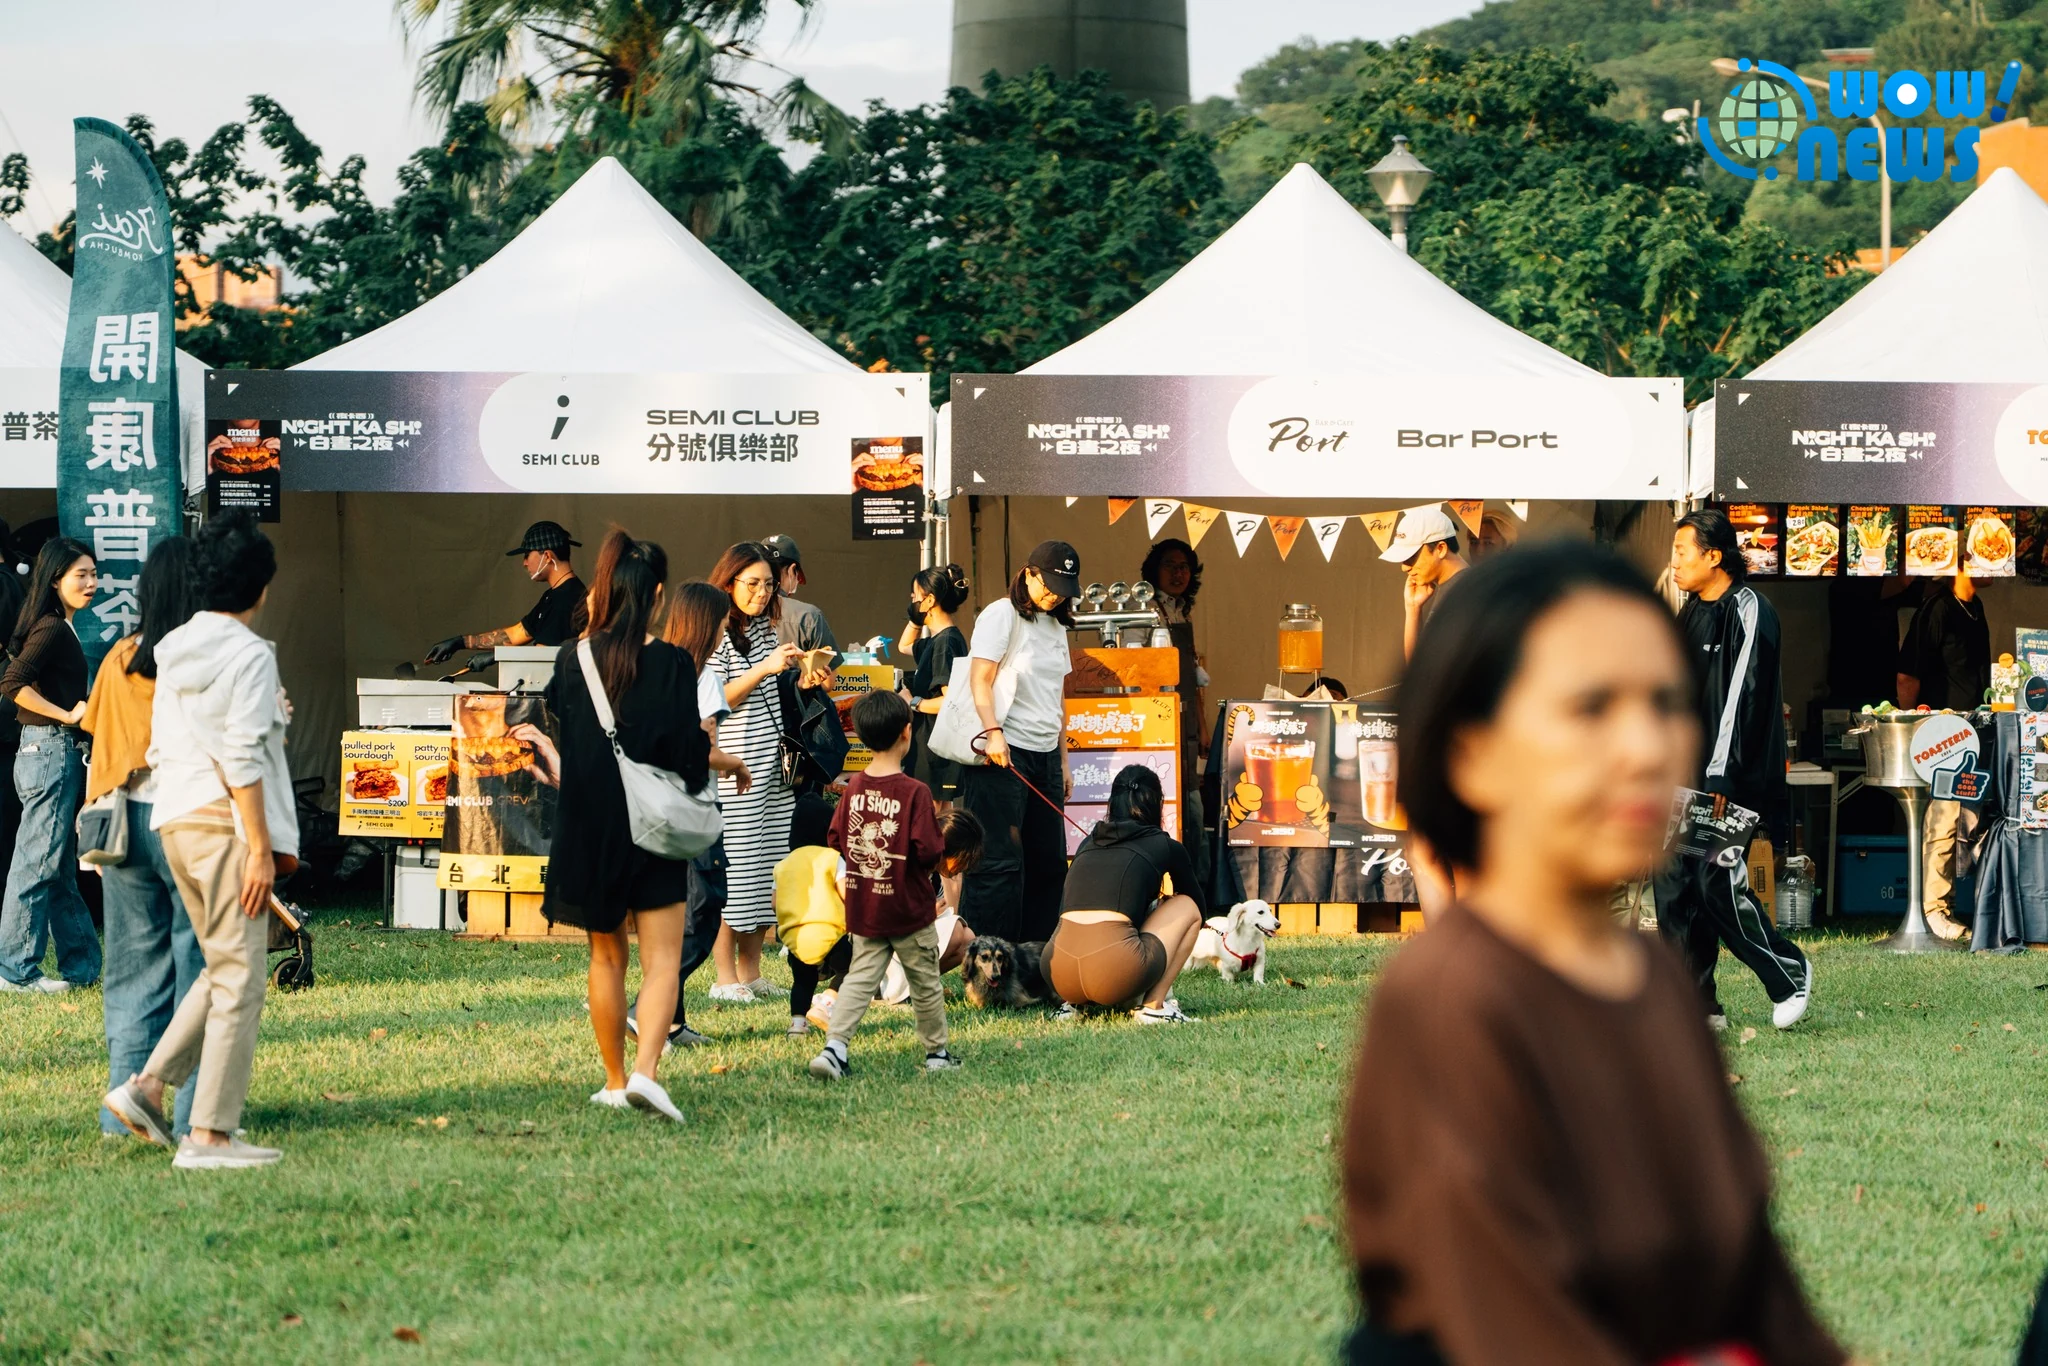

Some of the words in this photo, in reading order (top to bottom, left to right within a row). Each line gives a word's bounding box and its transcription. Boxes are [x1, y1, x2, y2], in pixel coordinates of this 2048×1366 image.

[646, 409, 726, 426] SEMI
[732, 409, 820, 426] CLUB
[227, 428, 261, 437] menu
[353, 420, 383, 435] KA
[1100, 424, 1131, 439] KA
[1268, 416, 1350, 453] Port
[1397, 429, 1464, 448] Bar
[1471, 430, 1559, 449] Port
[1865, 431, 1896, 446] KA
[646, 432, 799, 463] 分號俱樂部
[522, 453, 557, 466] SEMI
[561, 453, 600, 466] CLUB
[848, 674, 869, 683] melt
[832, 683, 873, 694] urdough
[344, 741, 372, 751] pulled
[374, 742, 396, 752] pork
[414, 744, 439, 753] patty
[1913, 728, 1973, 764] TOASTERIA
[344, 751, 394, 762] sourdough
[414, 753, 449, 761] sourdou
[1961, 772, 1977, 781] Only
[387, 800, 408, 808] $200
[463, 795, 493, 806] CLUB
[867, 795, 901, 819] SHOP
[1880, 886, 1895, 900] 60
